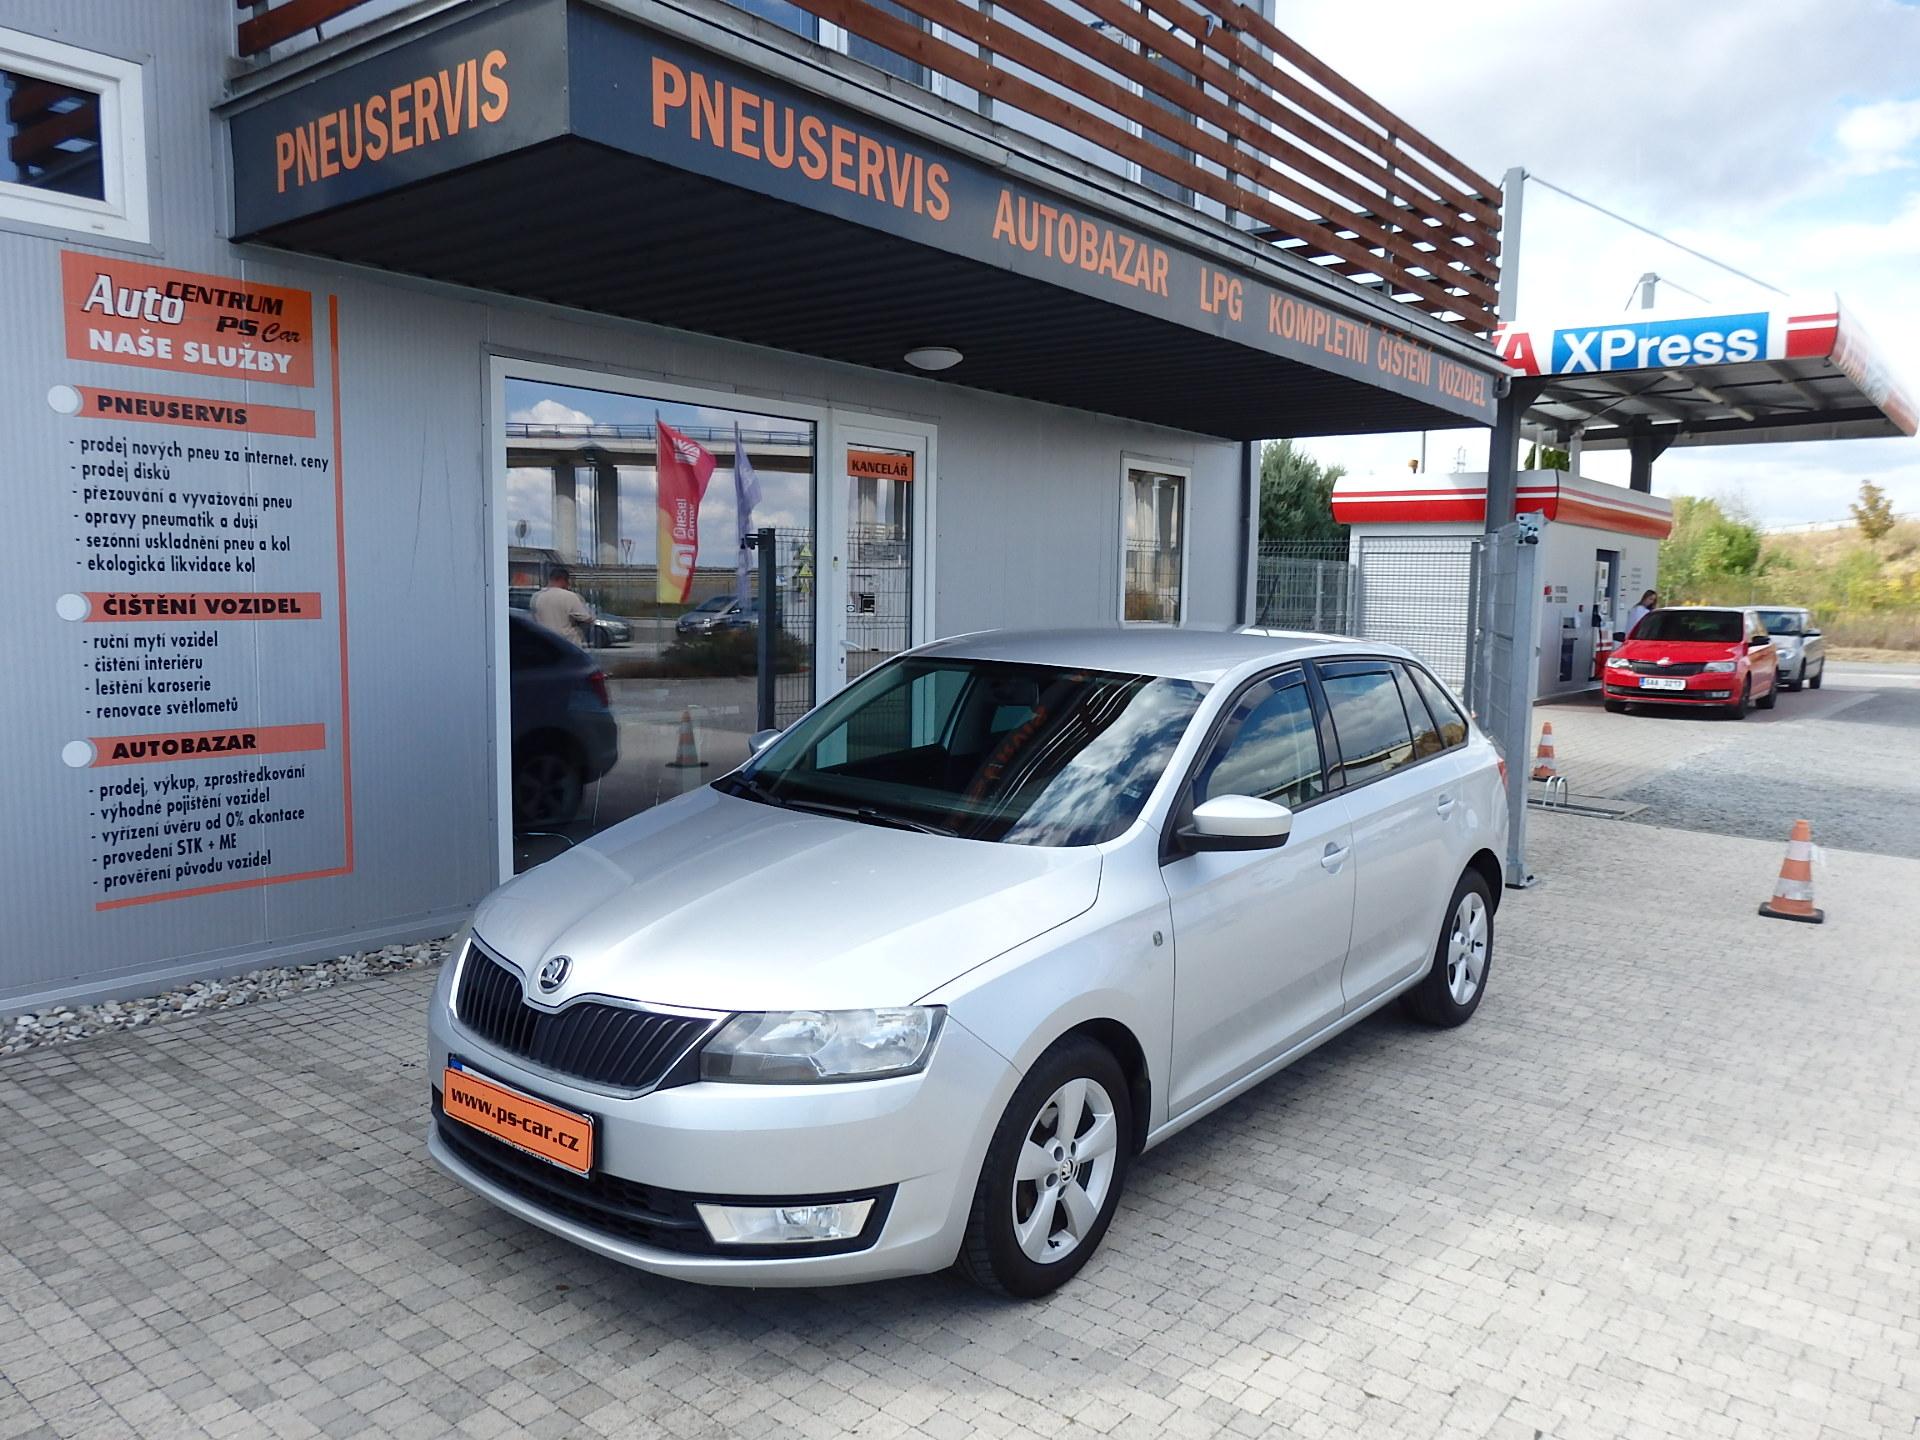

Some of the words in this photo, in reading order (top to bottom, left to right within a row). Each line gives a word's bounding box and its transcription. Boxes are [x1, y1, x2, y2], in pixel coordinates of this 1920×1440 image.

[276, 49, 509, 193] PNEUSERVIS
[651, 55, 951, 222] PNEUSERVIS
[991, 189, 1169, 297] AUTOBAZAR
[1199, 266, 1244, 323] LPG
[1268, 293, 1373, 365] KOMPLETNÍ
[1377, 324, 1435, 387] ČIŠTĚNÍ
[1438, 359, 1486, 408] VOZIDEL
[81, 272, 185, 326] Auto
[166, 281, 284, 316] CENTRUM
[216, 315, 260, 337] PS
[261, 322, 301, 343] Car
[89, 327, 173, 360] NAŠE
[183, 341, 293, 374] SLUŽBY
[1559, 327, 1760, 375] XPress
[97, 394, 248, 425] PNEUSERVIS
[81, 435, 127, 458] prodej
[132, 440, 182, 461] nových
[188, 446, 220, 462] pneu
[224, 450, 239, 462] za
[244, 446, 297, 467] internet.
[300, 456, 329, 473] ceny
[852, 458, 908, 476] KANCELÁŘ
[82, 459, 129, 483] prodej
[134, 461, 171, 480] disků
[83, 485, 164, 504] přezouvání
[168, 491, 177, 504] a
[182, 491, 258, 509] vyvažování
[262, 496, 293, 511] pneu
[85, 511, 136, 529] opravy
[142, 510, 215, 529] pneumatik
[220, 516, 228, 528] a
[233, 512, 258, 529] duší
[86, 531, 140, 548] sezónní
[145, 532, 219, 550] uskladnění
[224, 538, 255, 554] pneu
[259, 539, 267, 551] a
[271, 535, 291, 552] kol
[87, 553, 166, 576] ekologická
[170, 554, 231, 573] likvidace
[236, 555, 256, 573] kol
[103, 593, 197, 616] ČIŠTĚNÍ
[204, 598, 302, 614] VOZIDEL
[94, 632, 129, 649] ruční
[134, 632, 166, 652] mytí
[171, 630, 218, 648] vozidel
[95, 655, 140, 672] čištění
[145, 653, 203, 670] interiéru
[96, 677, 143, 696] leštění
[148, 675, 211, 693] karoserie
[97, 704, 162, 719] renovace
[167, 697, 239, 715] světlometů
[111, 733, 257, 760] AUTOBAZAR
[100, 777, 148, 802] prodej,
[153, 773, 199, 796] výkup,
[204, 763, 306, 790] zprostředkování
[101, 799, 162, 824] výhodné
[167, 793, 221, 817] pojištění
[226, 786, 270, 806] vozidel
[102, 822, 159, 847] vyřízení
[164, 819, 201, 835] úvěru
[205, 813, 221, 830] od
[226, 810, 245, 828] 0%
[248, 808, 305, 825] akontace
[103, 842, 173, 870] provedení
[177, 837, 204, 856] STK
[208, 840, 215, 850] +
[219, 833, 237, 850] ME
[104, 864, 171, 893] prověření
[175, 856, 223, 882] původu
[227, 849, 272, 870] vozidel
[450, 1086, 580, 1153] www.ps-car.cz
